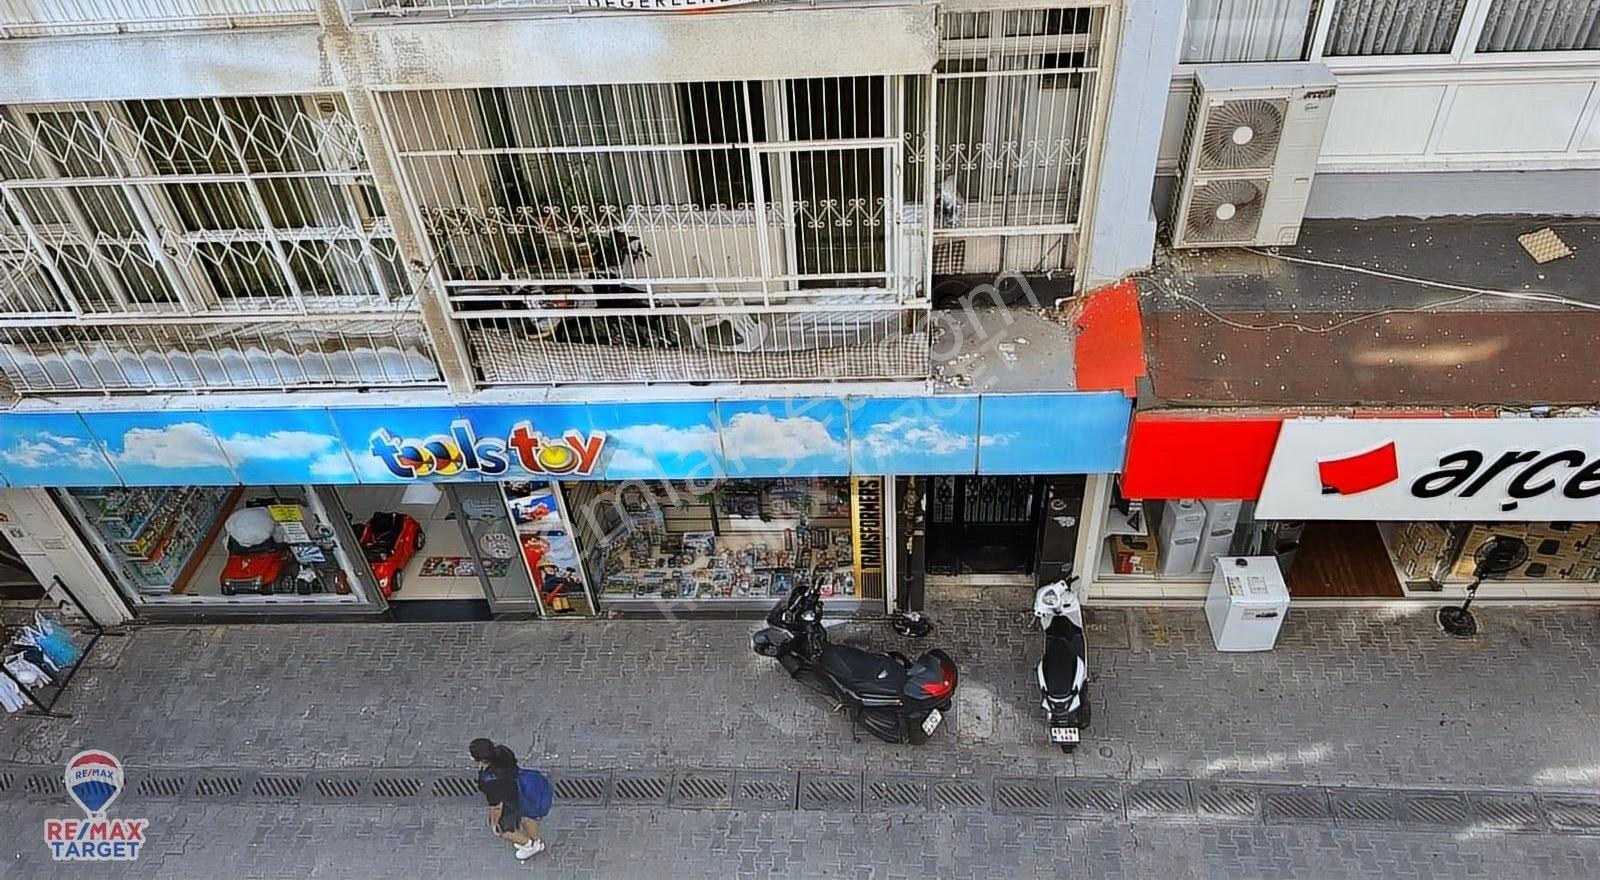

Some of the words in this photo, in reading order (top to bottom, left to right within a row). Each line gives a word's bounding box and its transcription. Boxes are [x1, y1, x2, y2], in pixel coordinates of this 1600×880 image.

[371, 421, 507, 477] tools
[508, 421, 606, 475] toy
[859, 479, 881, 569] TRANSFORMERS
